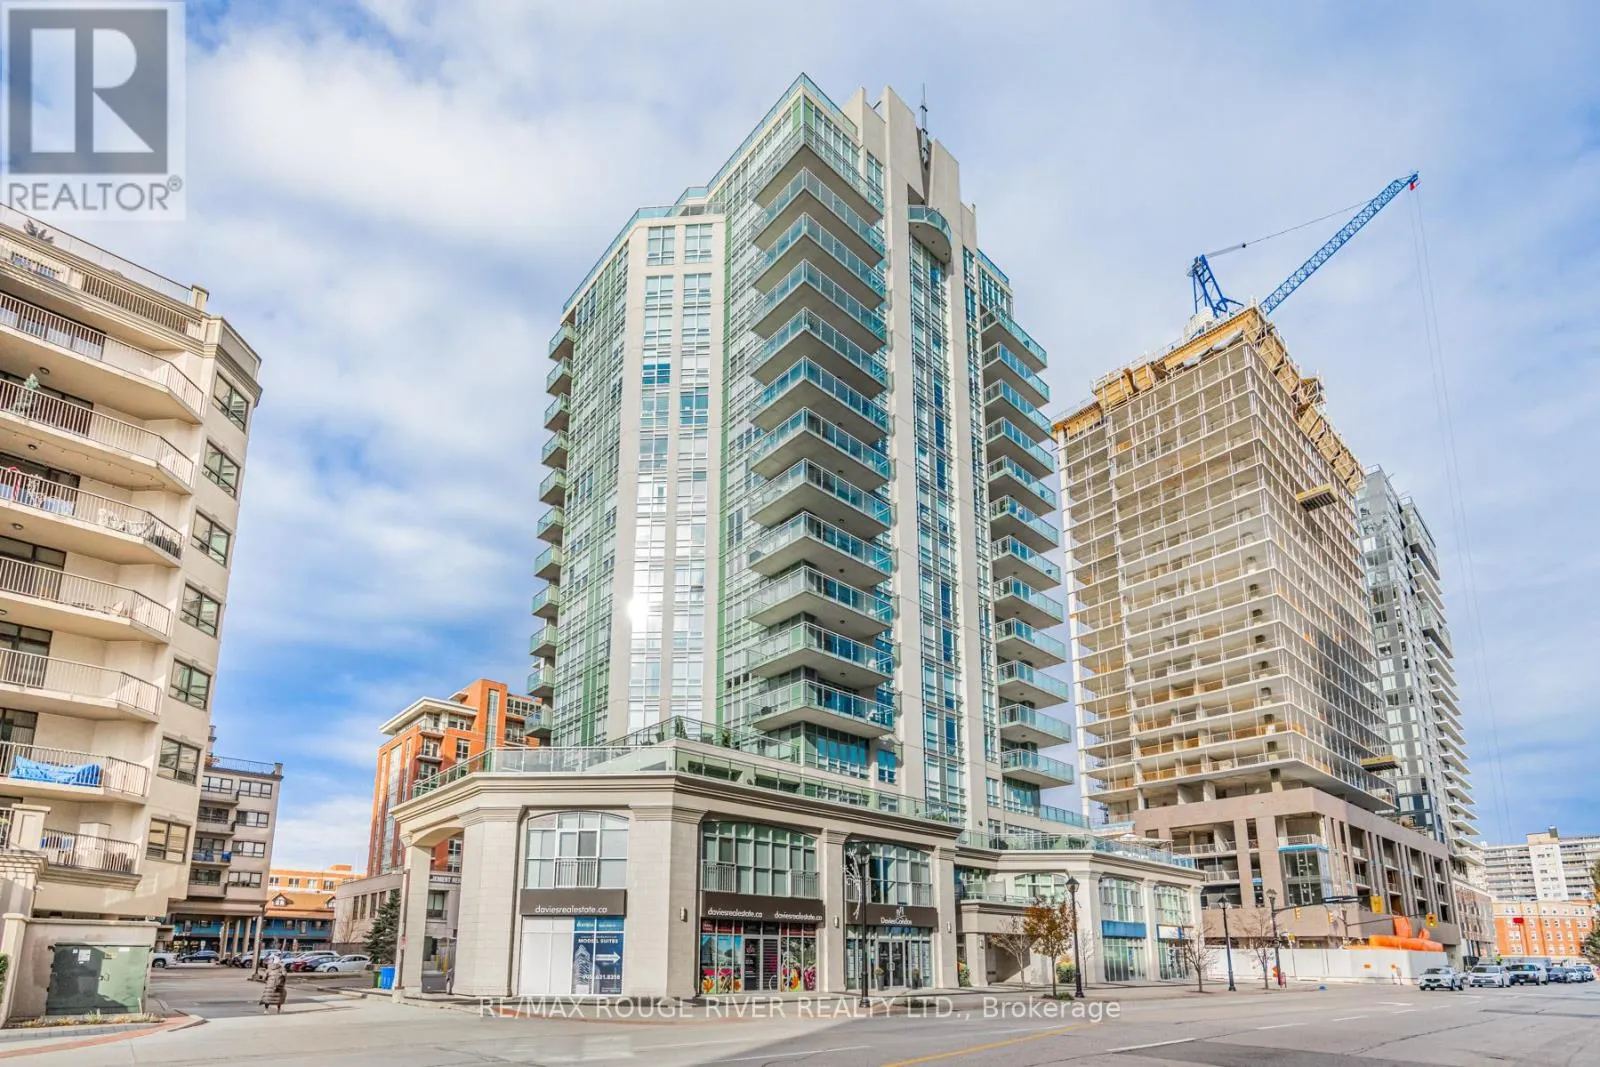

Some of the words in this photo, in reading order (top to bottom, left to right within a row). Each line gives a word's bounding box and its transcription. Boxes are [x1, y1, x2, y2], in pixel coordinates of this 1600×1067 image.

[535, 904, 608, 914] daviesrealestate.ca
[707, 907, 763, 918] daviesrealestate.ca
[774, 911, 823, 921] daviesrealestate.ca
